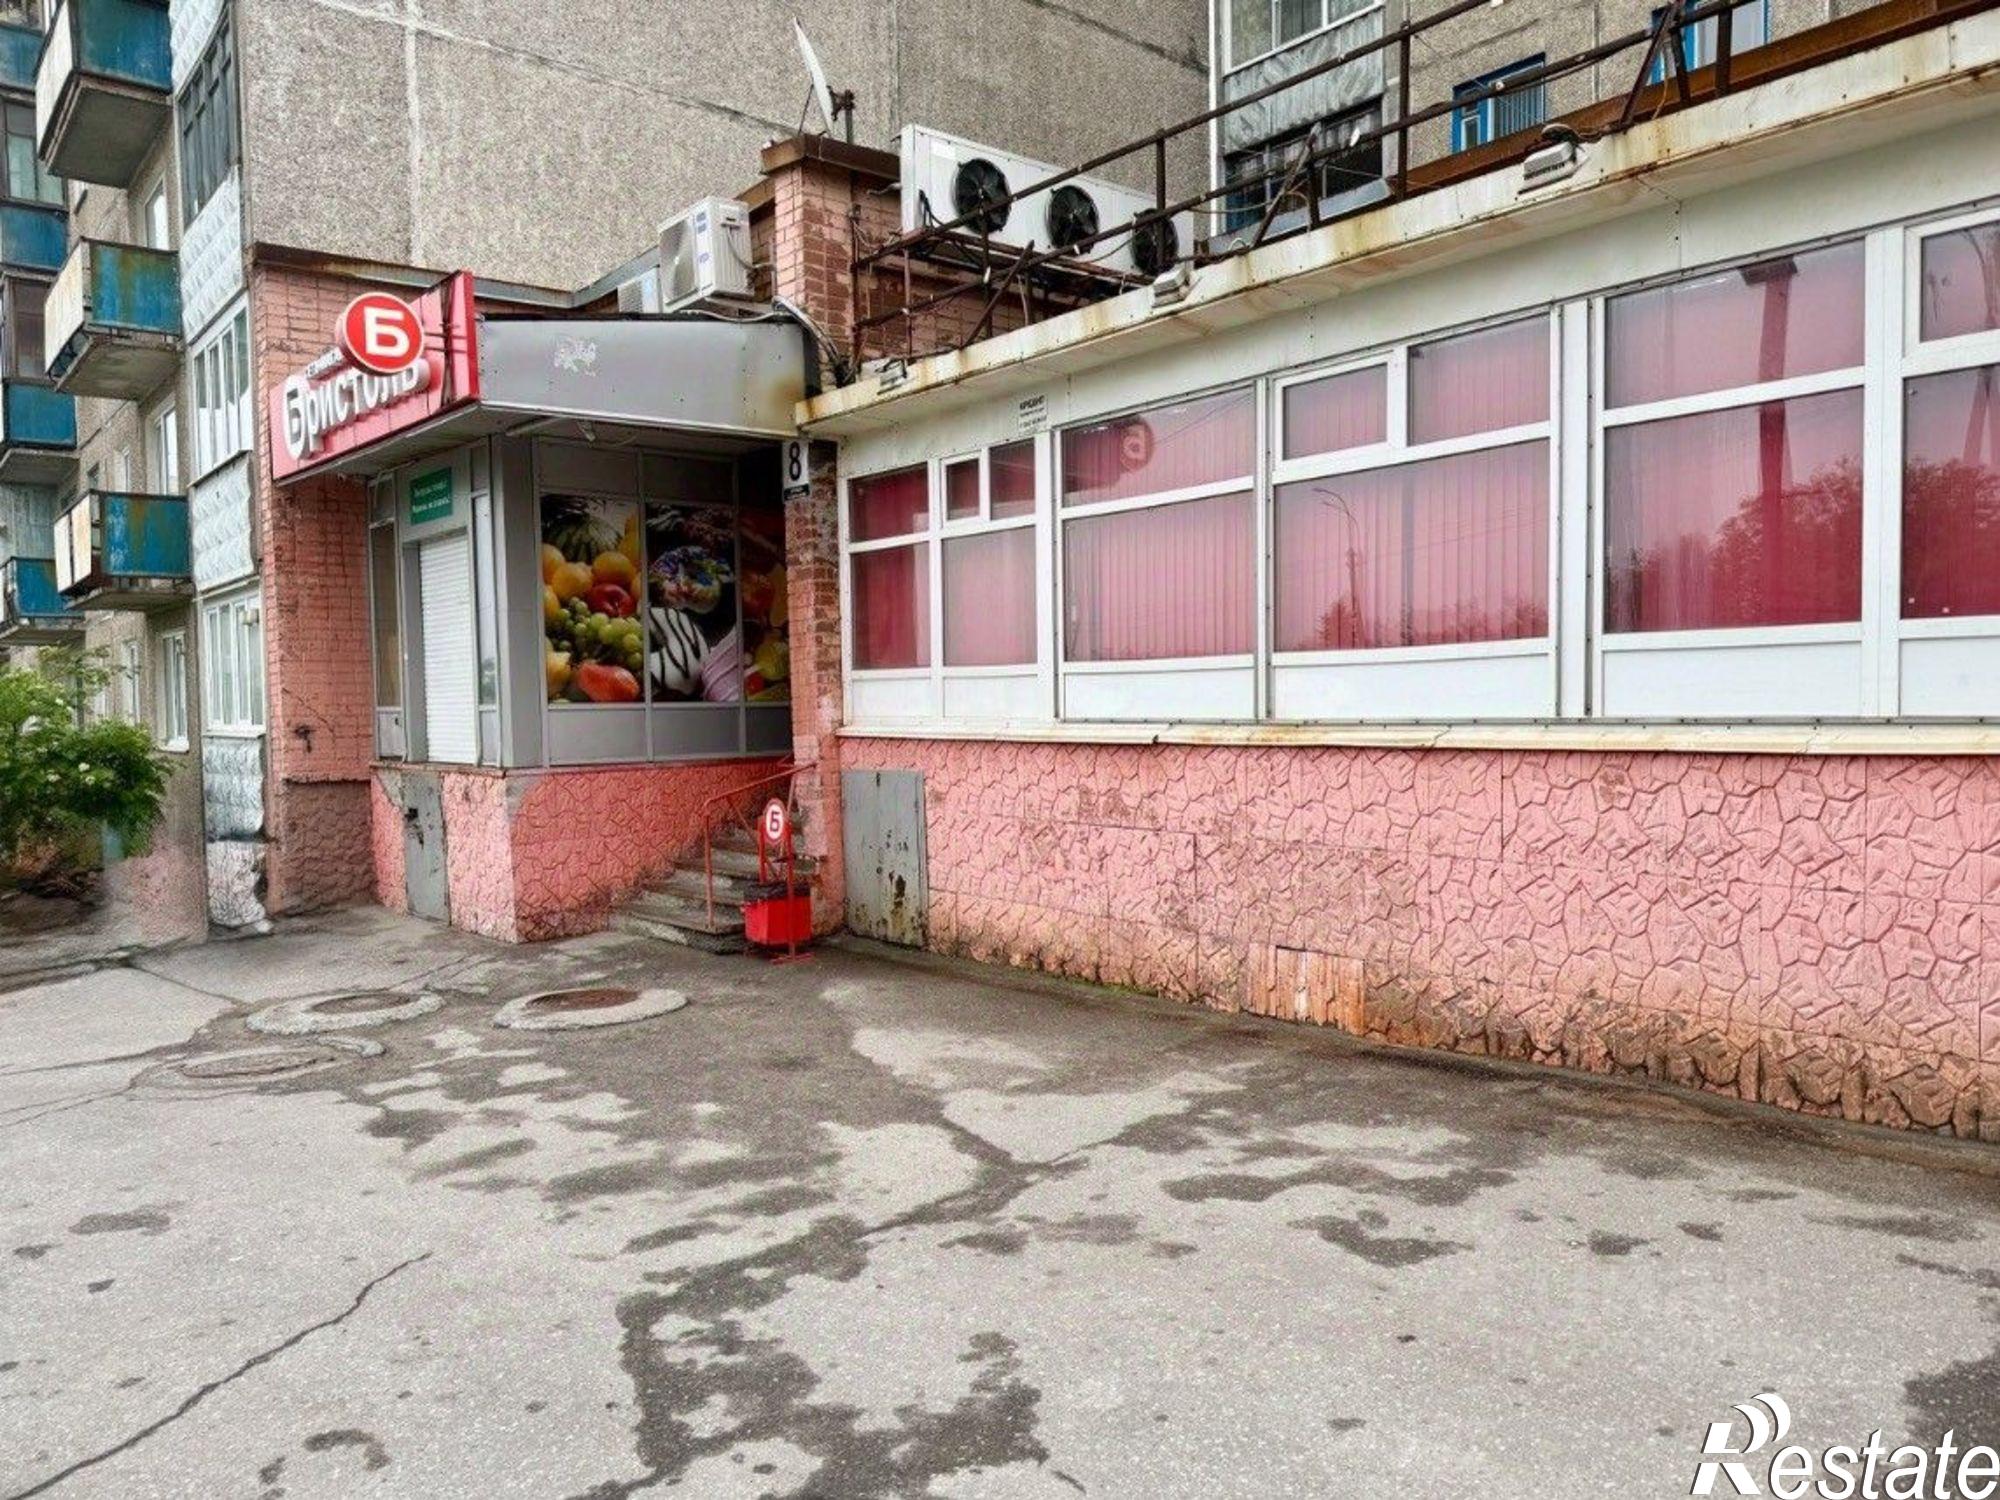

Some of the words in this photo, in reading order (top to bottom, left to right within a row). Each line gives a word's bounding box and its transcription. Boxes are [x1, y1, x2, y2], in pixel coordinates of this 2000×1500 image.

[363, 306, 410, 358] Б
[283, 359, 420, 459] Бристоль
[788, 441, 802, 481] 8
